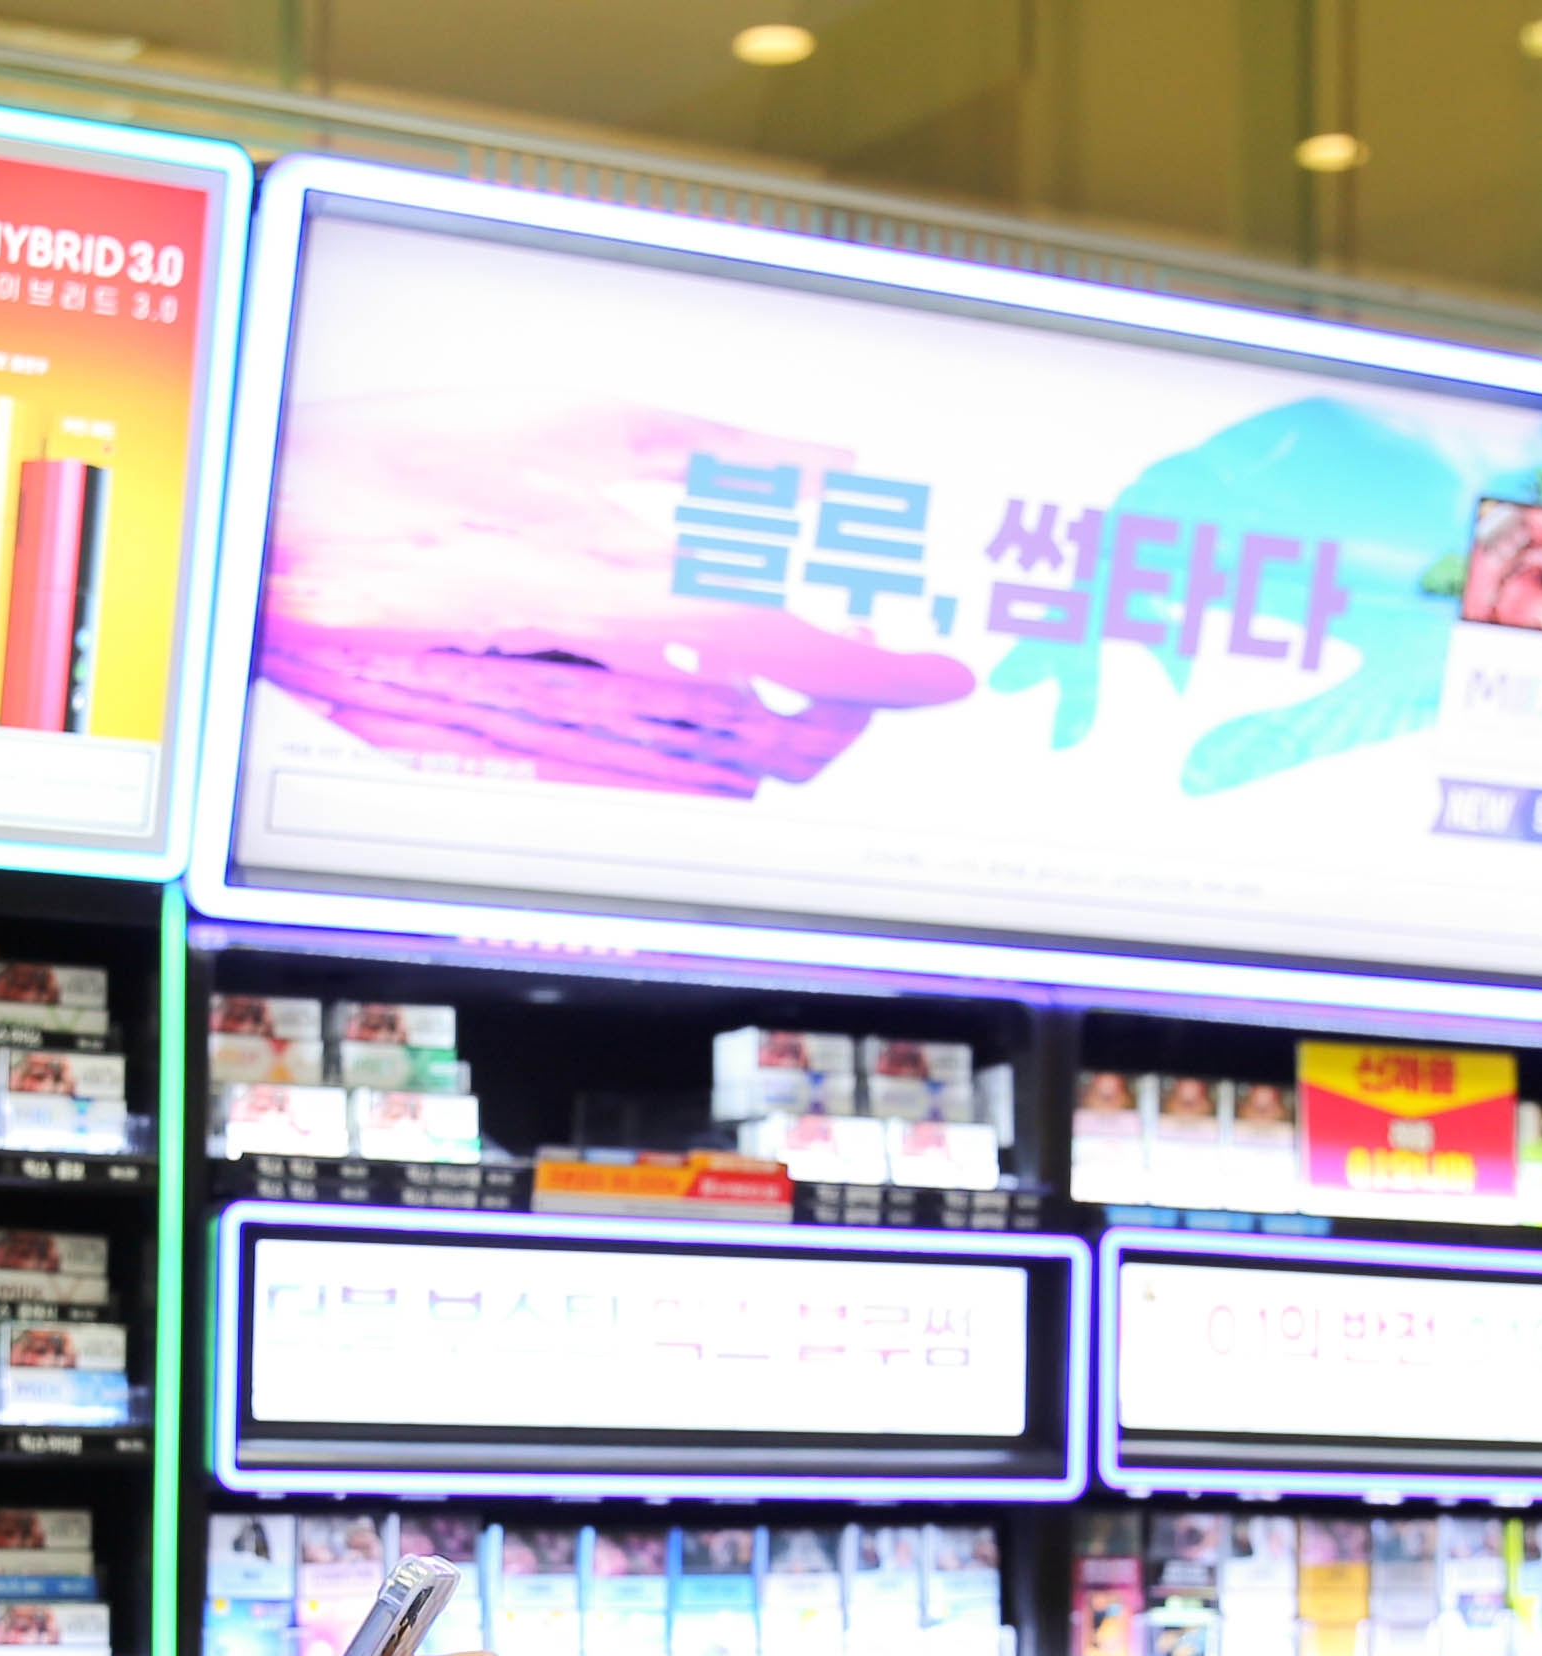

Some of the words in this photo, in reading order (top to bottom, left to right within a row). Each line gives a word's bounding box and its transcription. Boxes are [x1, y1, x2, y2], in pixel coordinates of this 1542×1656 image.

[126, 239, 184, 287] 3.0
[131, 290, 178, 324] 3.0
[983, 497, 1350, 672] 썸타다
